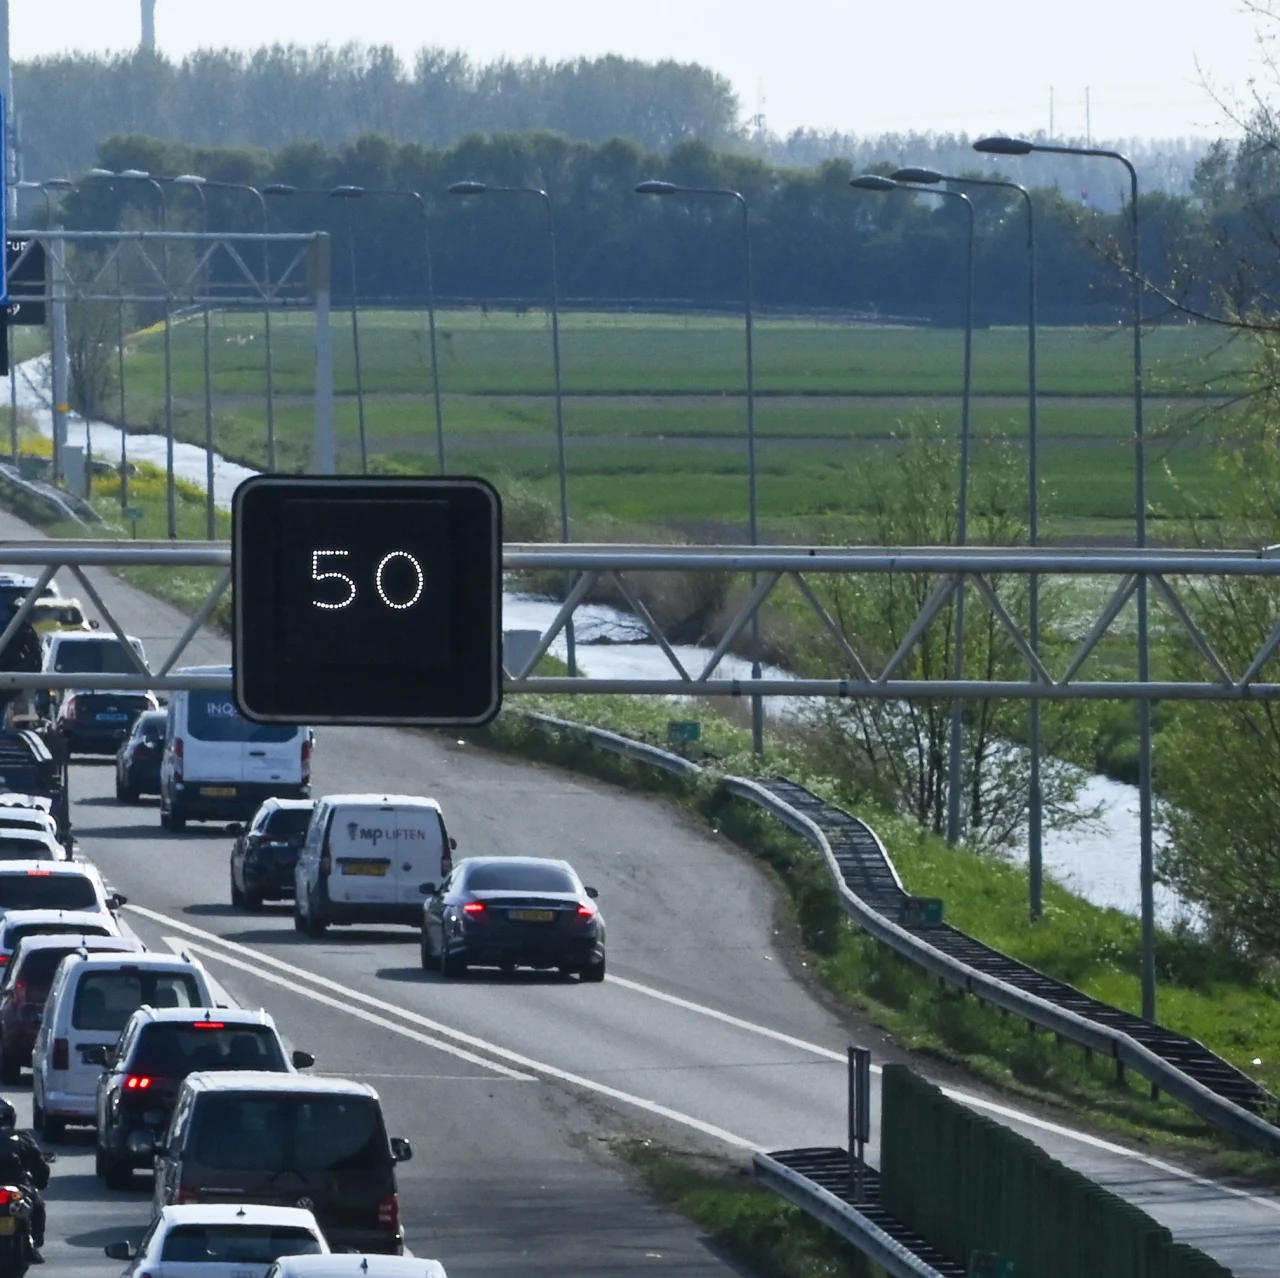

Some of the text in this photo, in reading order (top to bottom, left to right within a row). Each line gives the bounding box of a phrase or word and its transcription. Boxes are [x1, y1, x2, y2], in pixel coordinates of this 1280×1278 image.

[311, 549, 425, 610] 50
[206, 703, 238, 717] INQ
[385, 829, 426, 842] LIFTEN
